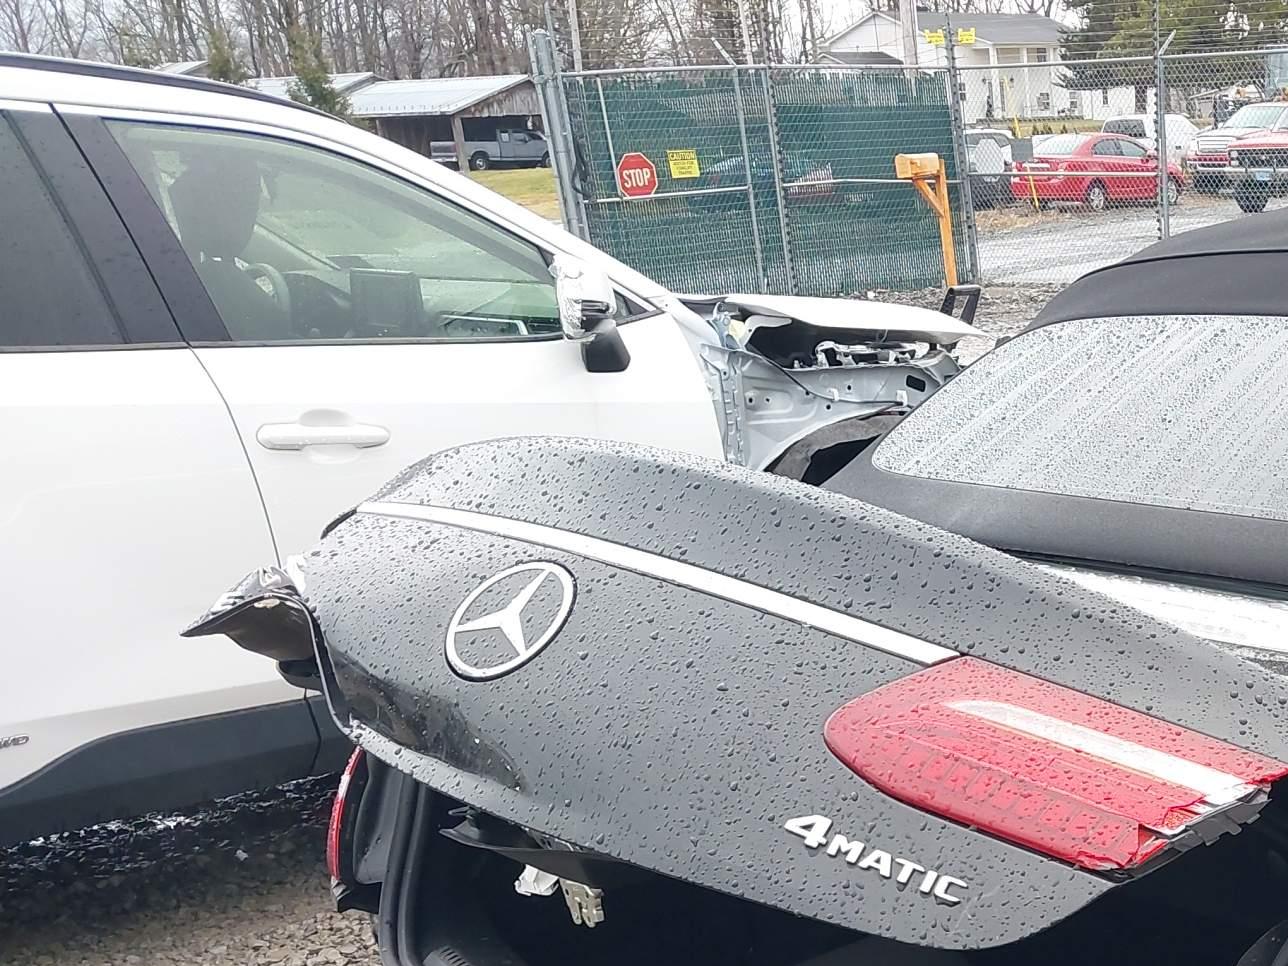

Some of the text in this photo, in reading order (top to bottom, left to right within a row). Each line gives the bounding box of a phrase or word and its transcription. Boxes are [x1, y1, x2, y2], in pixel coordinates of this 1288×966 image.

[669, 152, 695, 161] CAUTION
[622, 168, 651, 188] STOP
[783, 814, 969, 903] 4MATIC
